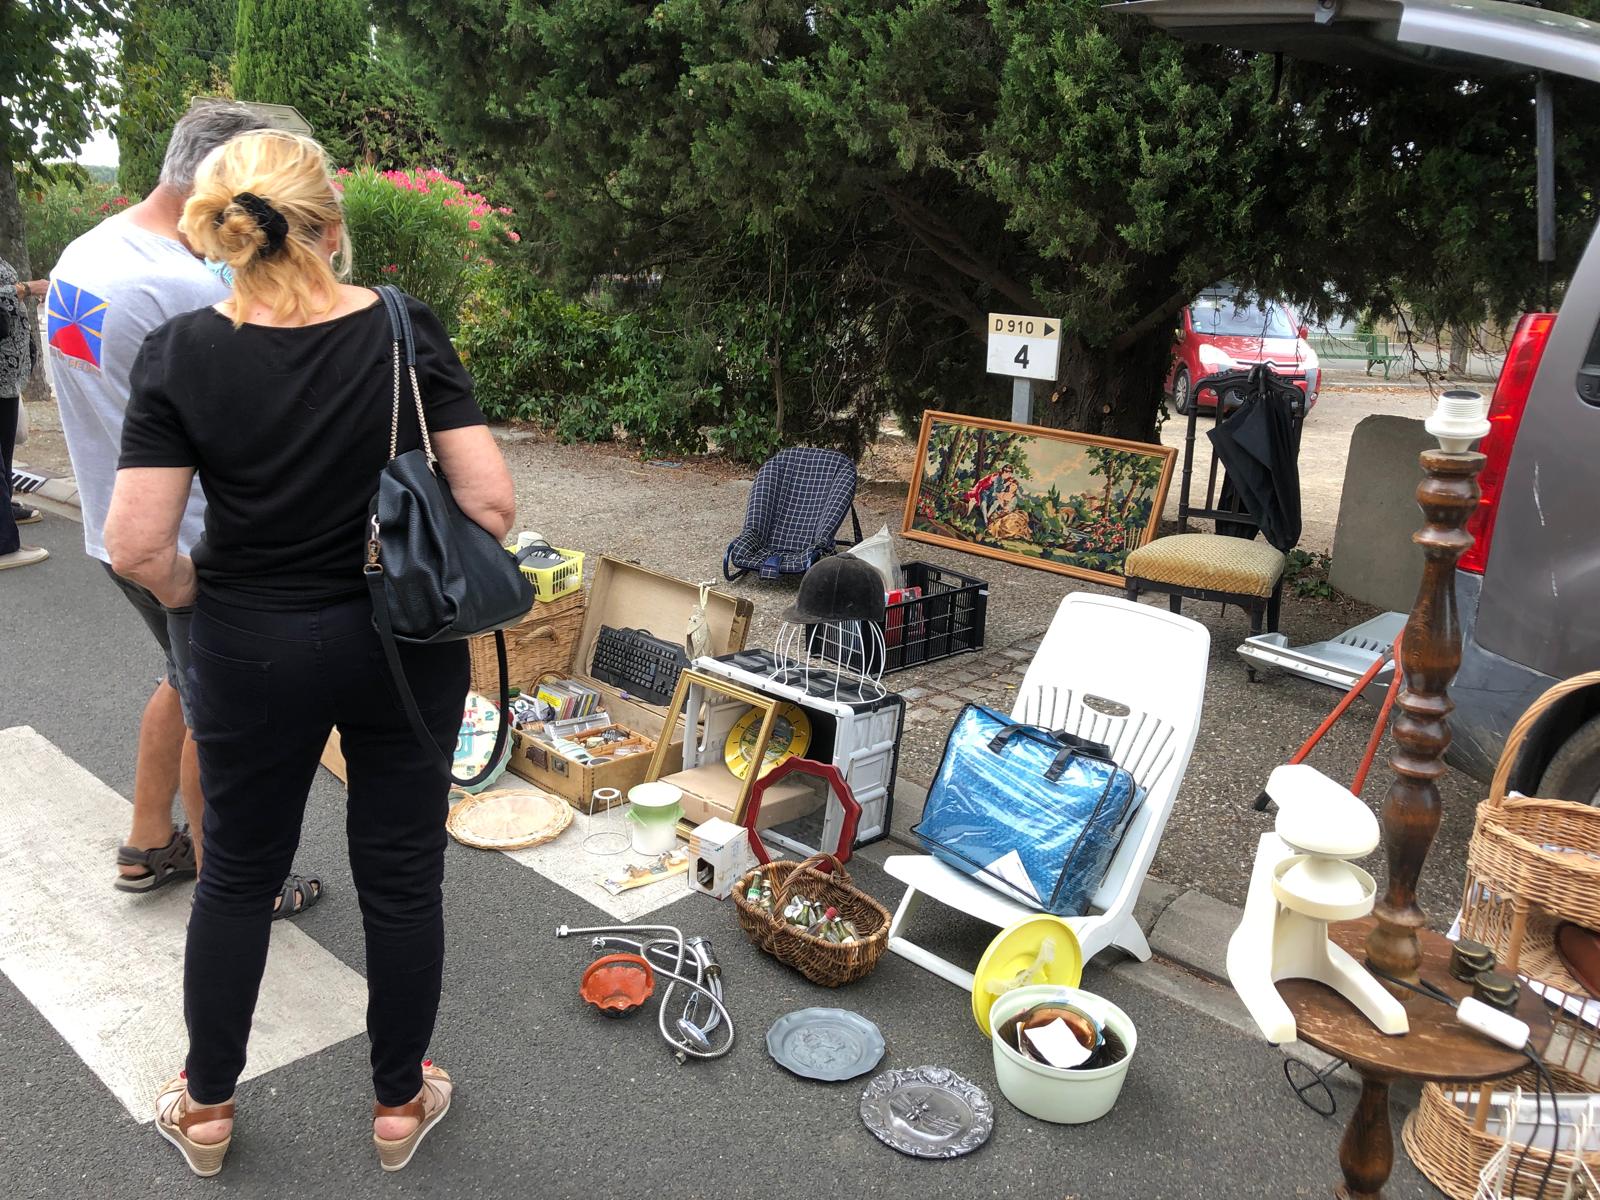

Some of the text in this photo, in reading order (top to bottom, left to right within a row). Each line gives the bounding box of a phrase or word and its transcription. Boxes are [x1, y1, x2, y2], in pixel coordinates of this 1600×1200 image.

[995, 319, 1034, 334] D 910
[1014, 344, 1030, 369] 4
[484, 710, 495, 721] 2
